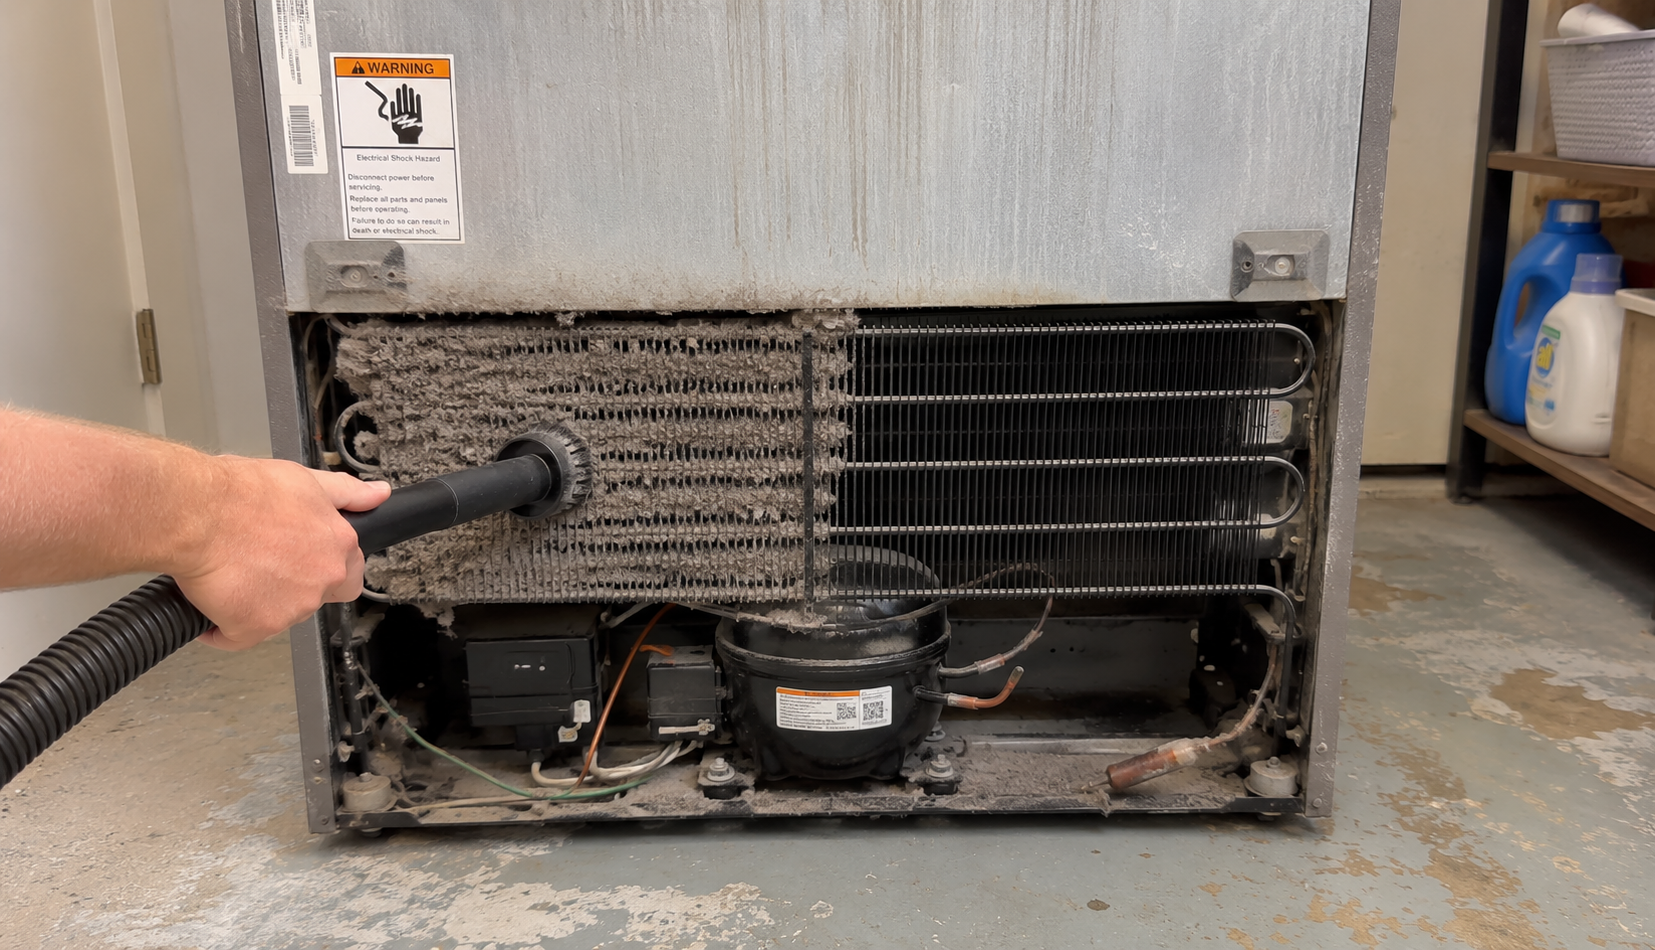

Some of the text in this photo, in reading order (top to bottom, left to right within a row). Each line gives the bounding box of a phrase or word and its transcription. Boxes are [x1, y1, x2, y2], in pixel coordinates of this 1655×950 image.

[367, 62, 434, 75] WARNING
[391, 154, 413, 162] Shock
[348, 173, 387, 181] Disconnect
[411, 174, 435, 182] before
[350, 195, 378, 203] Replace
[377, 217, 385, 225] to
[1536, 343, 1553, 370] all
